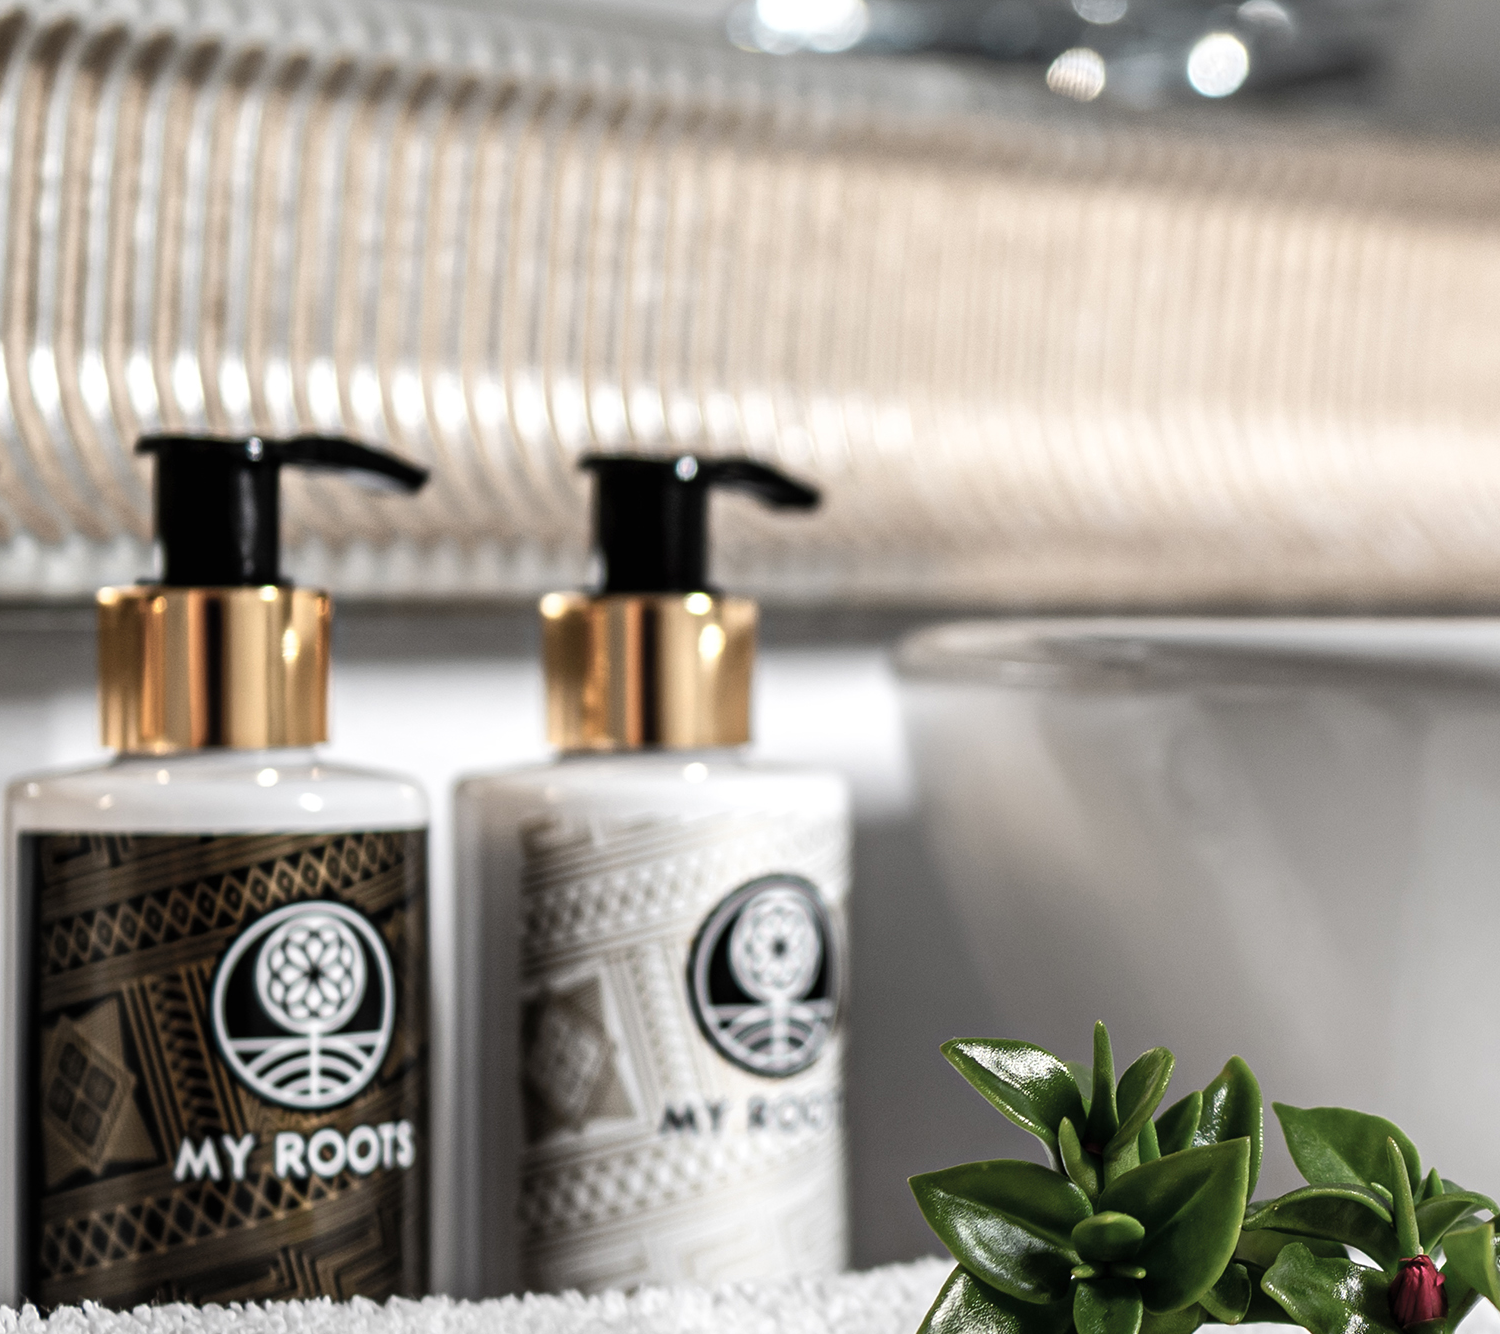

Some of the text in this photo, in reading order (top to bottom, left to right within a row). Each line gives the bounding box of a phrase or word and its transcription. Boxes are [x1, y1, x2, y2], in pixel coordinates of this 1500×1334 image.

[657, 1097, 728, 1135] MY
[174, 1119, 416, 1182] MY ROOTS
